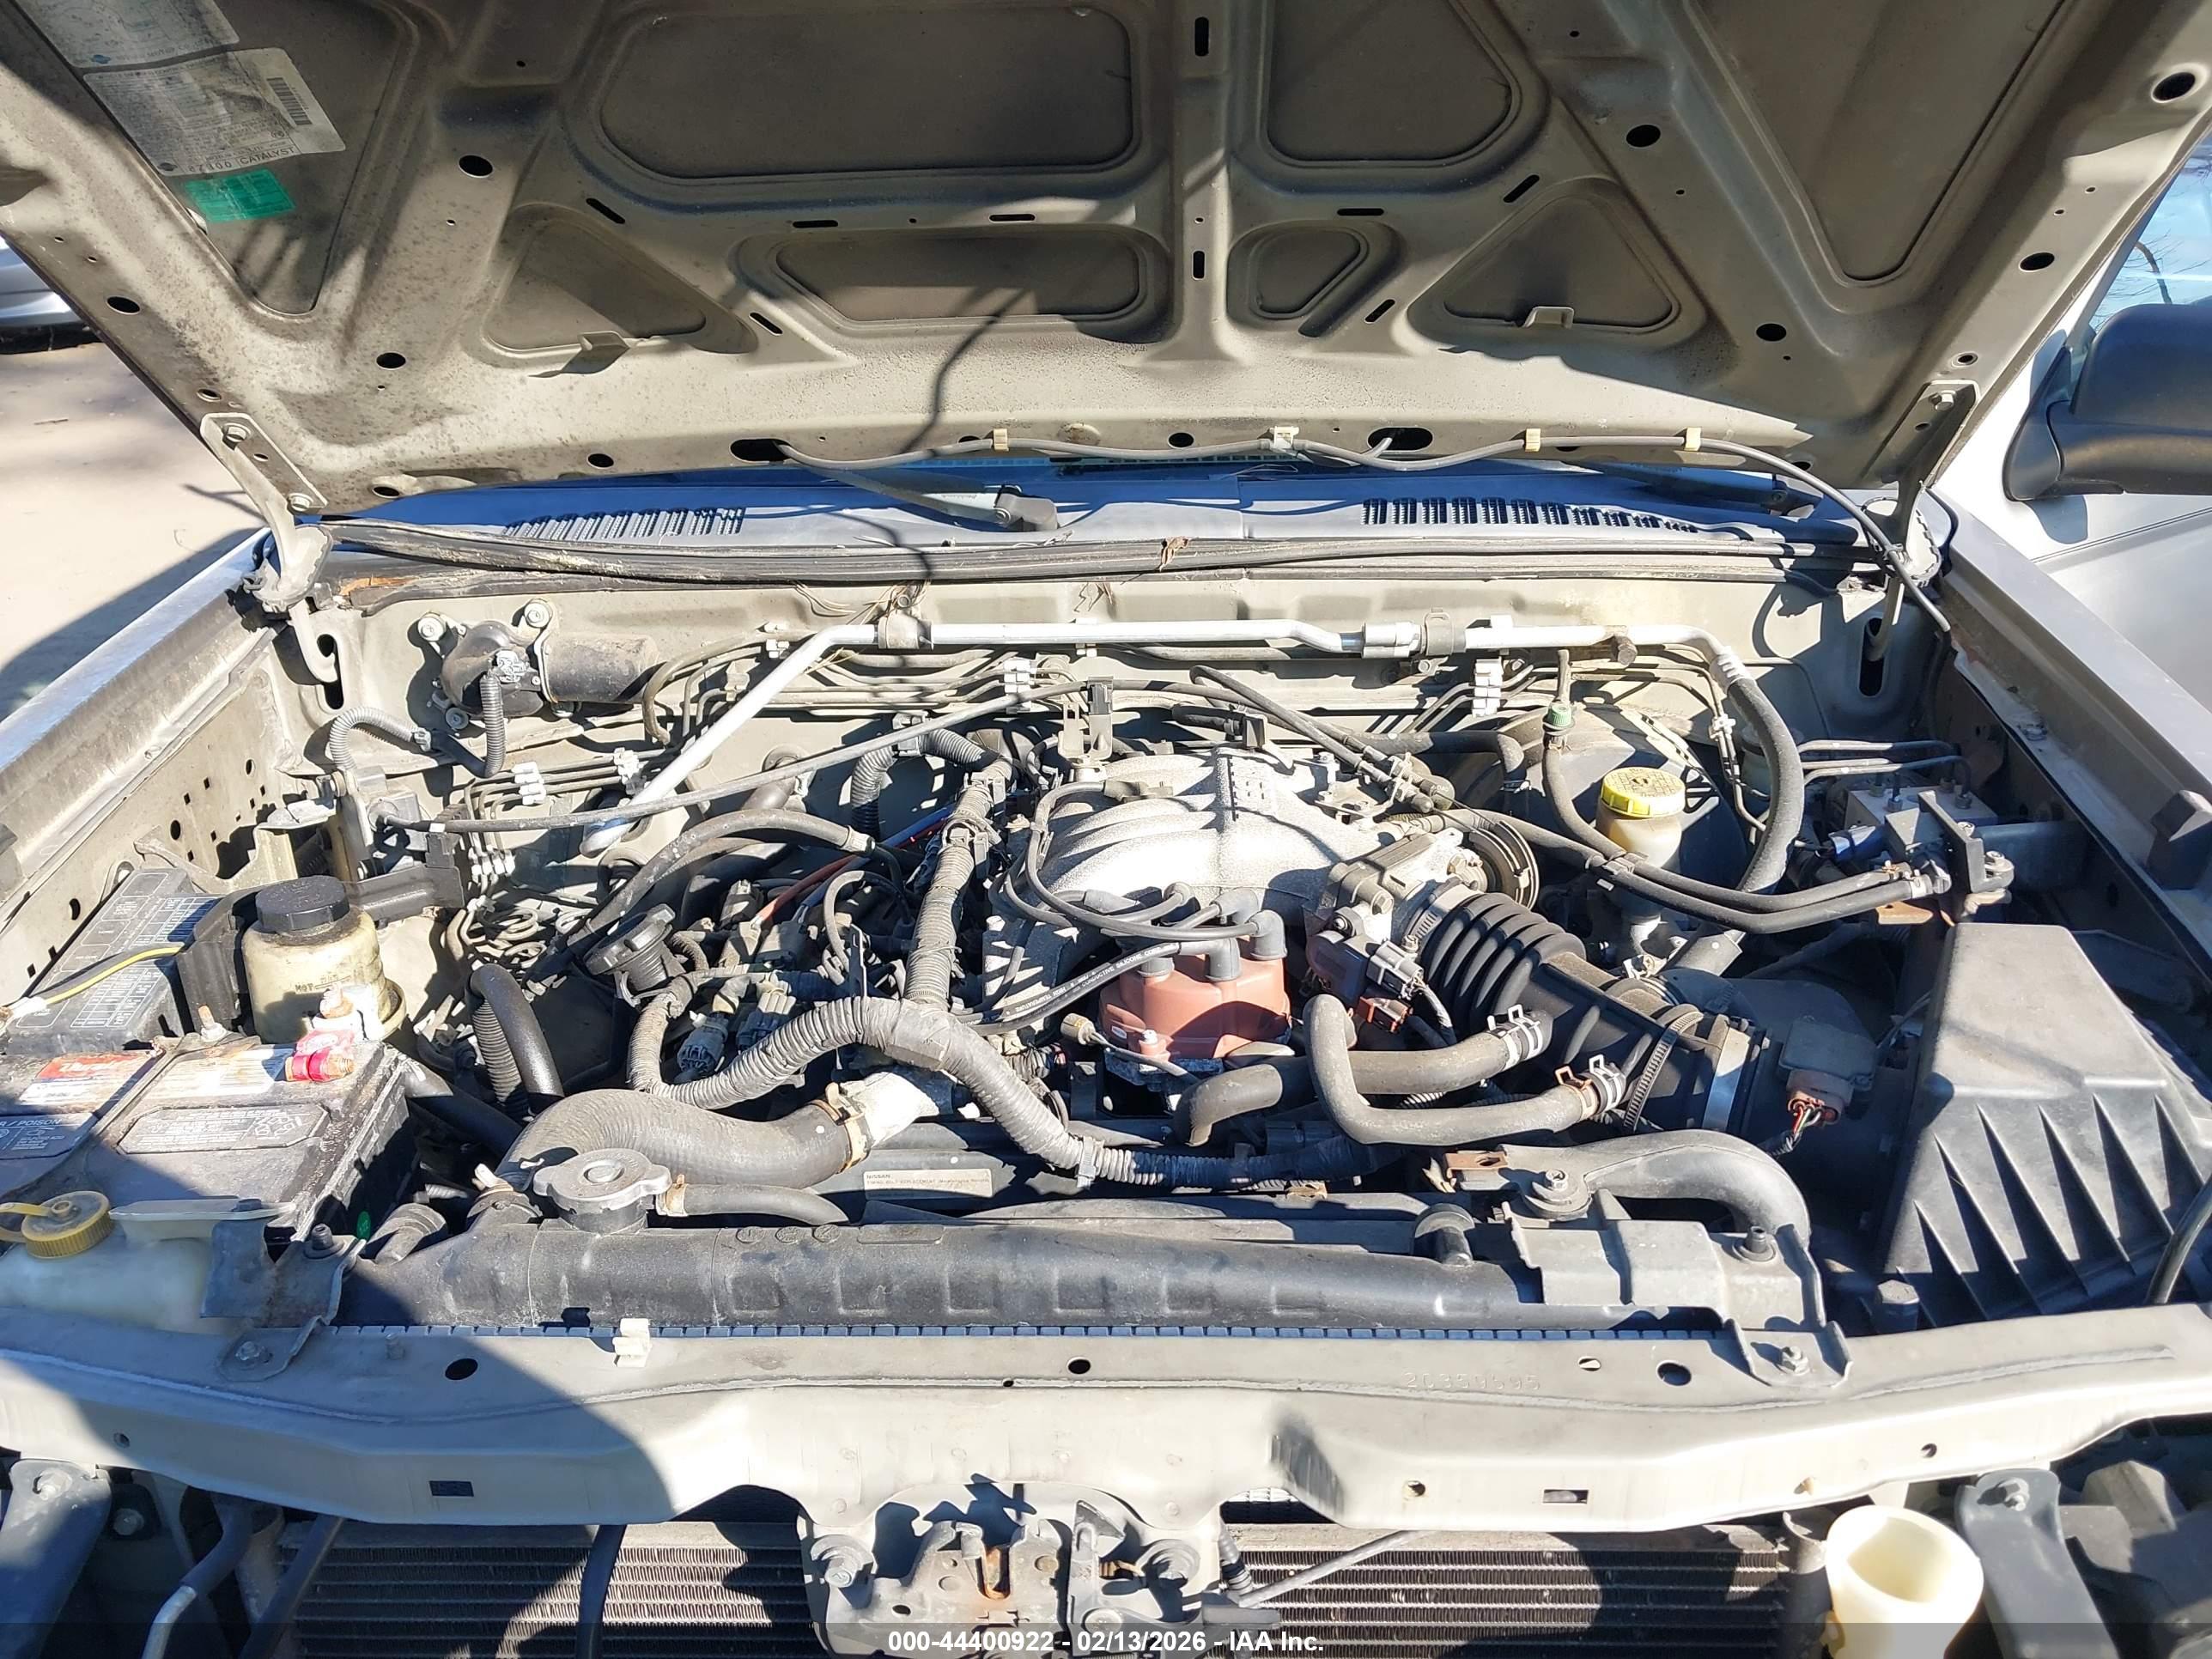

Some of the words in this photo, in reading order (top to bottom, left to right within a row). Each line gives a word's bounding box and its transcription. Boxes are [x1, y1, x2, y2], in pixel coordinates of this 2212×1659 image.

[240, 146, 295, 165] CATALYST
[1081, 965, 1115, 988] CONDUCTIVE
[1115, 952, 1143, 969] SILICONE
[1014, 994, 1052, 1012] TEMPERATURE
[17, 1118, 63, 1127] POISON
